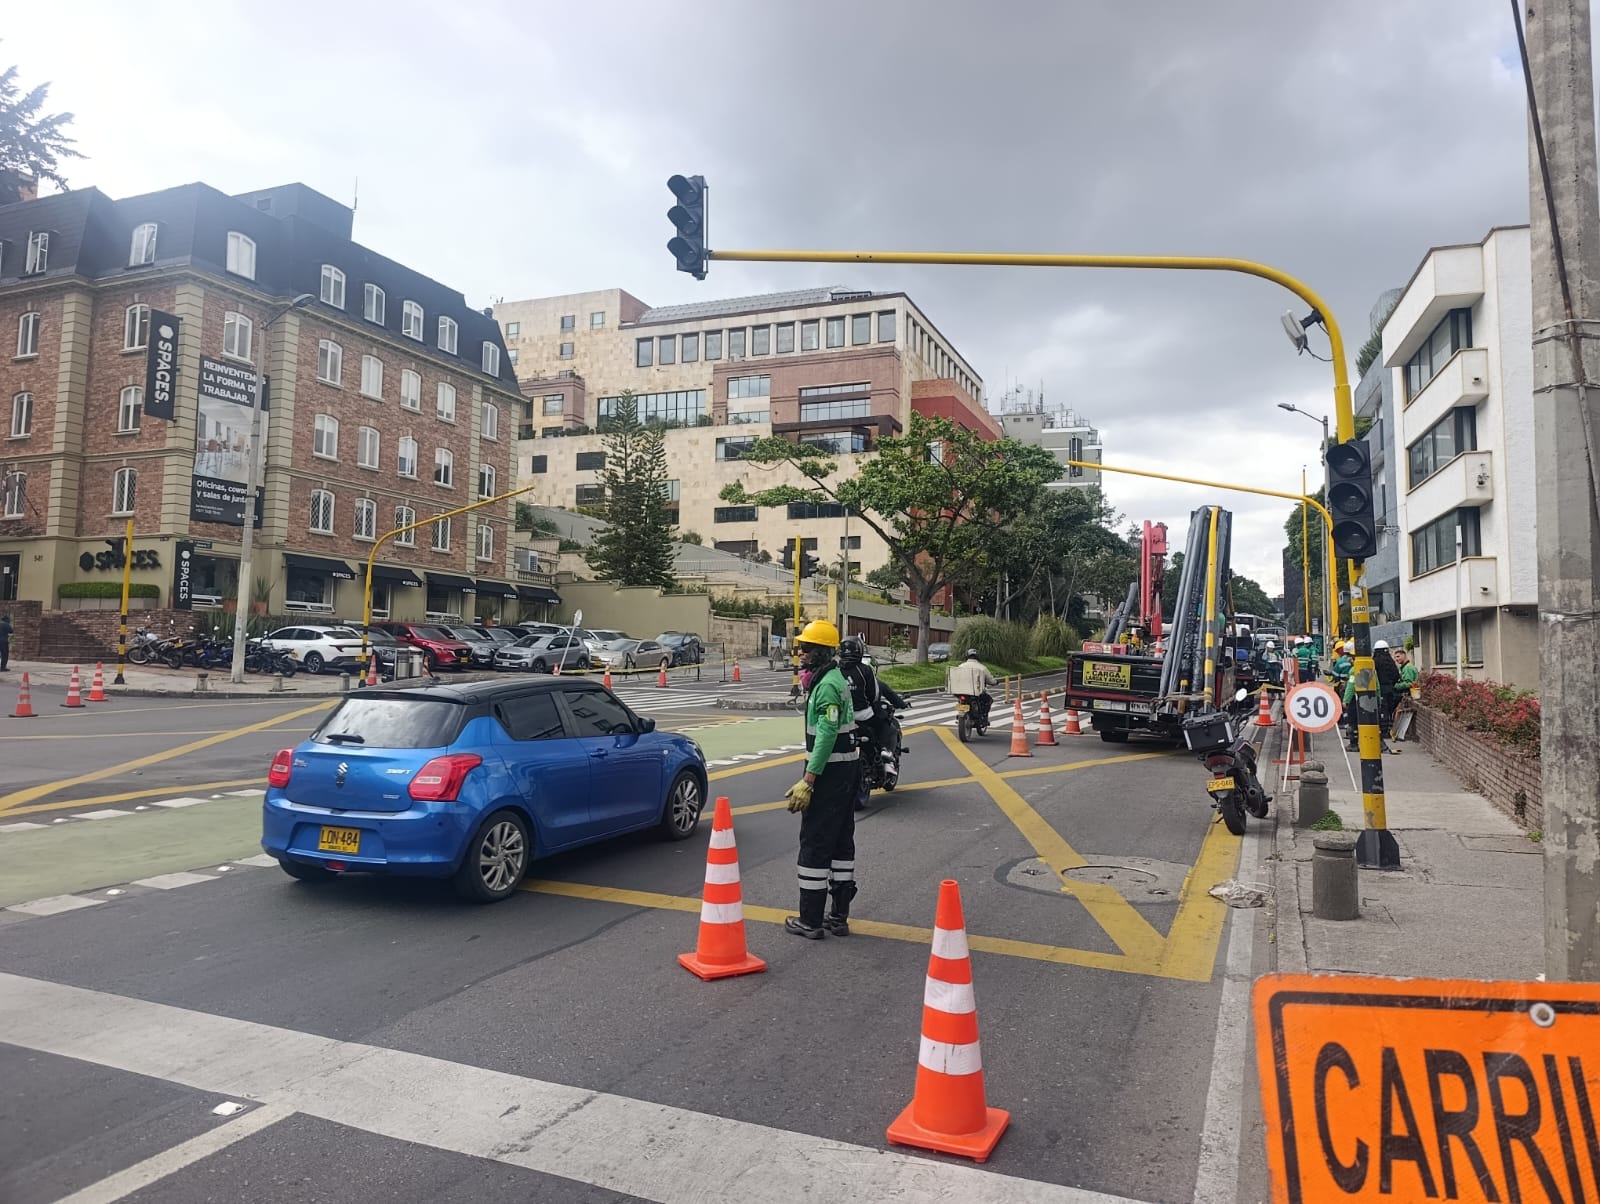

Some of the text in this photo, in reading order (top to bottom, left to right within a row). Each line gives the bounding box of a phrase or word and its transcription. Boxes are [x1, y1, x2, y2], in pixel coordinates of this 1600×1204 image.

[154, 340, 172, 404] SPACES.
[203, 372, 257, 394] LA FORMA DE
[204, 360, 266, 385] REINVENTEMS
[203, 384, 250, 404] TRABAJAR.
[196, 480, 227, 492] Oficinas,
[196, 490, 202, 498] y
[203, 491, 221, 500] salas
[180, 561, 190, 602] SPACES.
[1296, 695, 1329, 719] 30
